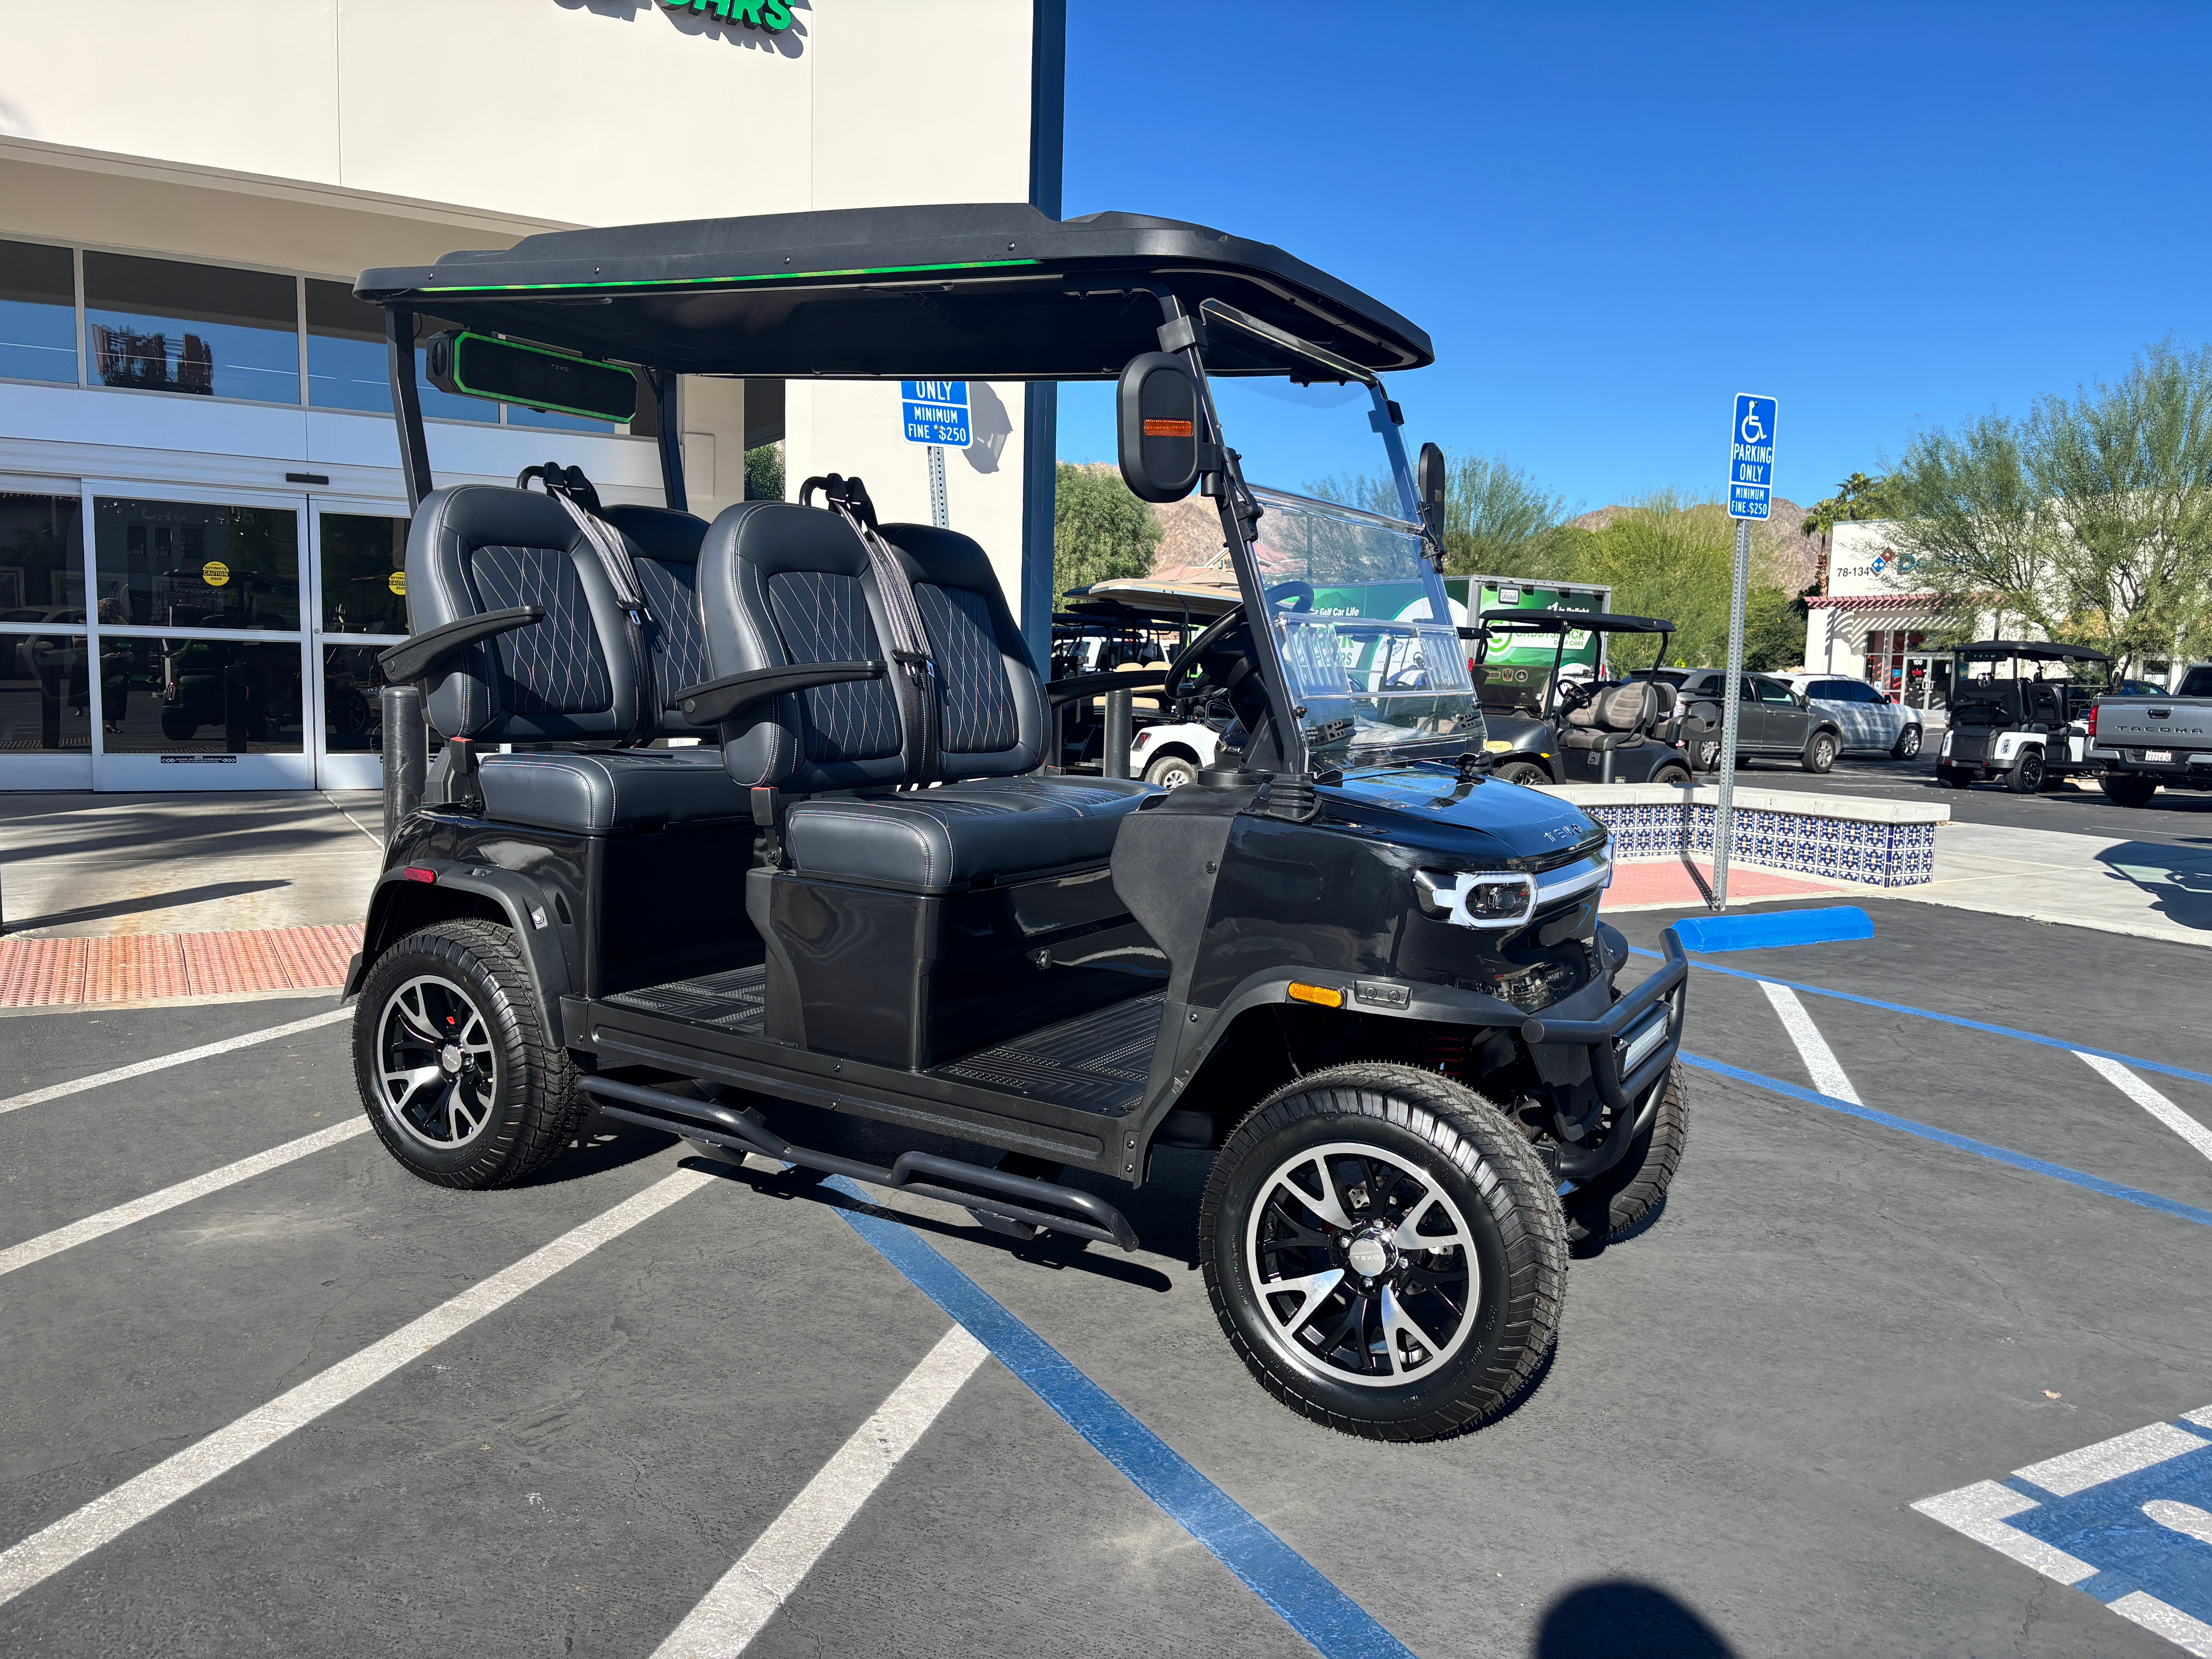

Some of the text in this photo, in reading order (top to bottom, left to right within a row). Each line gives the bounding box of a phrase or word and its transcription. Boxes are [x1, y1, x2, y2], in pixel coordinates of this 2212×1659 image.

[663, 0, 792, 31] RS
[916, 381, 952, 400] ONLY
[914, 406, 958, 424] MINIMUM
[908, 423, 966, 442] FINE $250
[1733, 443, 1772, 464] PARKING
[1740, 464, 1764, 482] ONLY
[1736, 487, 1764, 501] MINIMUM
[1731, 501, 1767, 515] FINE $250
[1837, 567, 1869, 577] 78-134
[1320, 608, 1332, 616] Golf
[1333, 607, 1345, 616] Car
[1345, 607, 1360, 616] Life
[2115, 726, 2203, 734] TACOMA
[1544, 824, 1582, 843] TEKO
